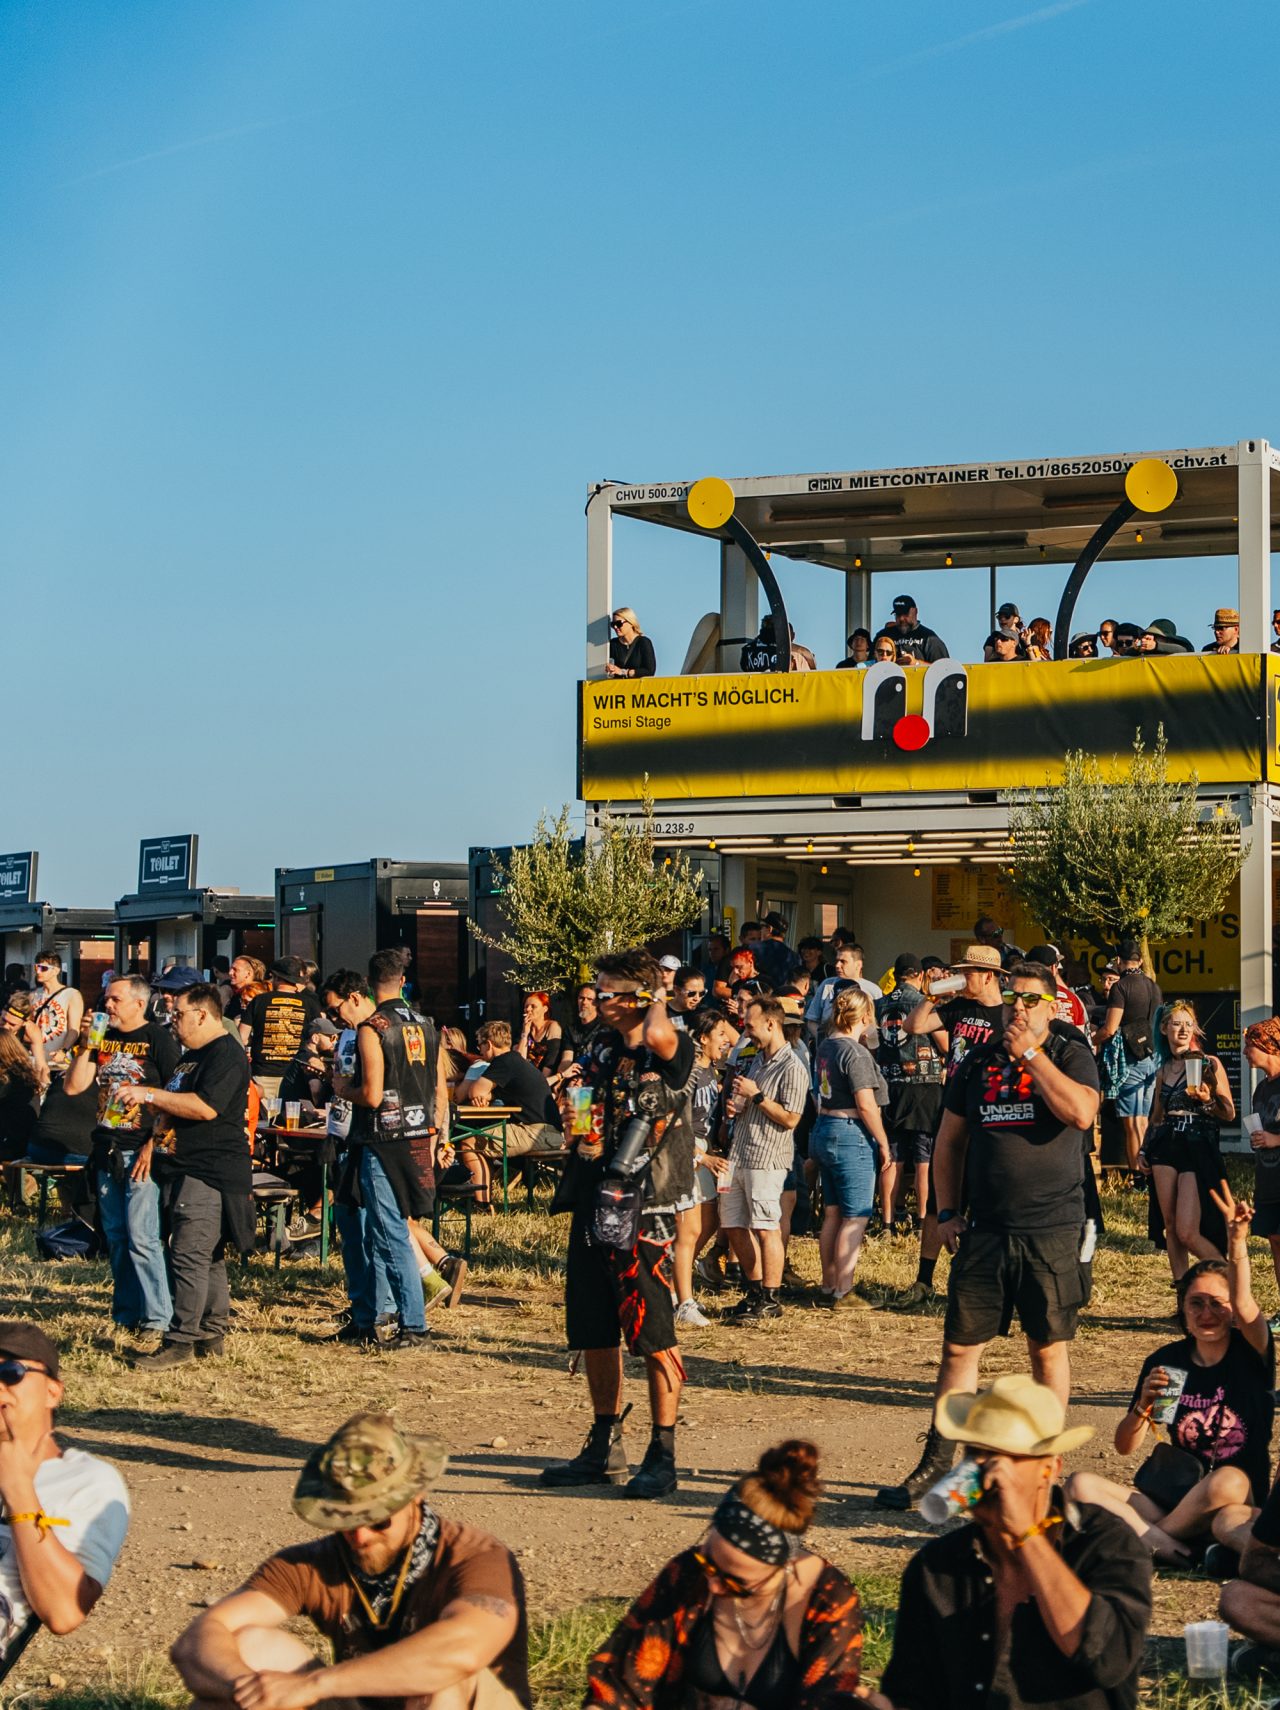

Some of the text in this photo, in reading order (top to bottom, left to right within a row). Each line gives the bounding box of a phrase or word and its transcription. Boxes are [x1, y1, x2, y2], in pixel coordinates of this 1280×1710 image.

[850, 453, 1227, 489] MIETCONTAINER Tel. 01/8652050 w.chv.at
[808, 478, 843, 491] CHV
[616, 489, 645, 501] CHVU
[593, 686, 800, 710] WIR MACHT'S MÖGLICH.
[593, 715, 672, 731] Sumsi Stage
[642, 822, 695, 835] 0.238-9
[151, 855, 180, 873] TOILET
[967, 1017, 983, 1027] CLUB
[953, 1022, 994, 1045] PARTY
[123, 1041, 150, 1056] ROCK
[980, 1103, 1034, 1116] UNDER
[981, 1112, 1034, 1122] ARMOUR
